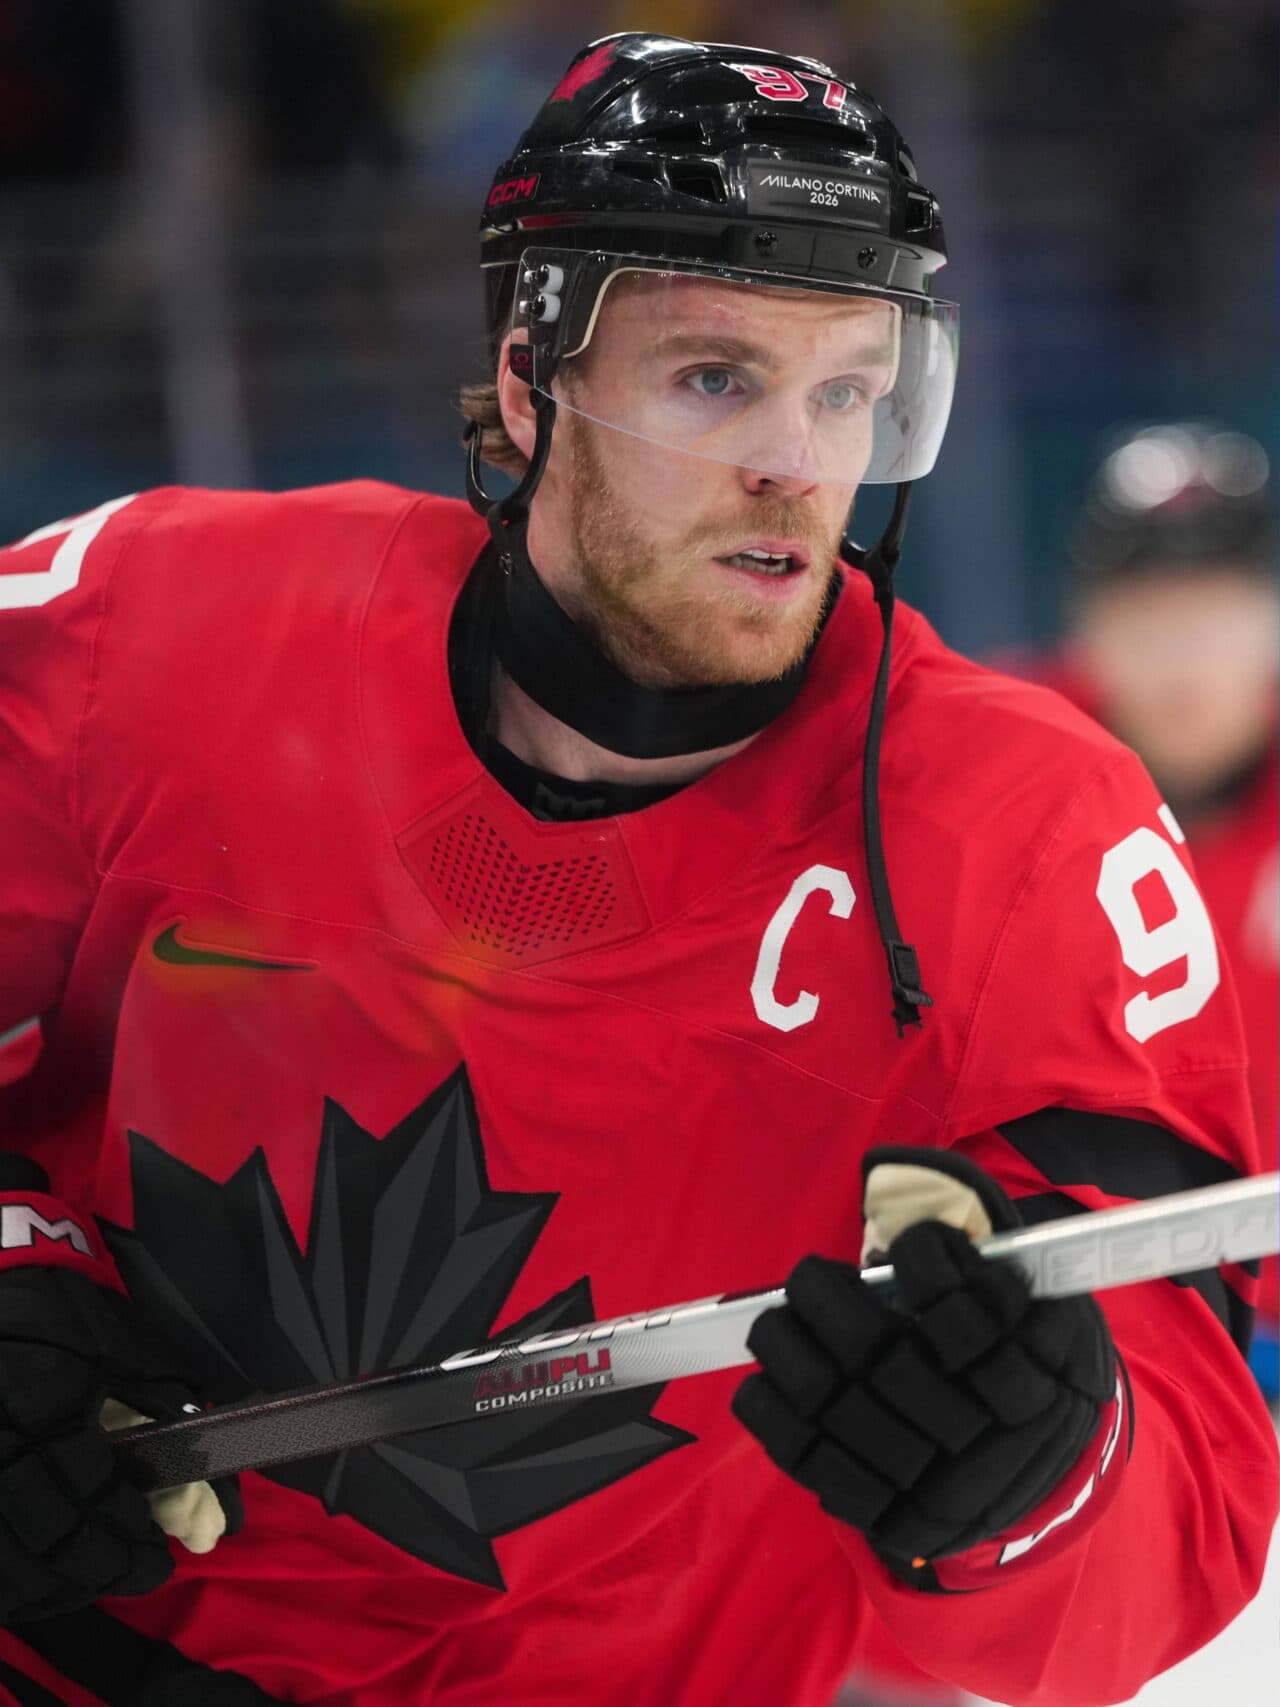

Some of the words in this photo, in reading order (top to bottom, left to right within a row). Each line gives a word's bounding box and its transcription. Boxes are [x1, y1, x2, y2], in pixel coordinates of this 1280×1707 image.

[741, 65, 846, 109] 97
[489, 175, 538, 206] CCM
[760, 175, 822, 192] MILANO
[825, 182, 880, 203] CORTINA
[810, 192, 839, 207] 2026
[1096, 804, 1220, 1043] 9
[750, 864, 856, 1032] C
[473, 1347, 612, 1400] ALUPLI
[475, 1373, 616, 1412] COMPOSITE
